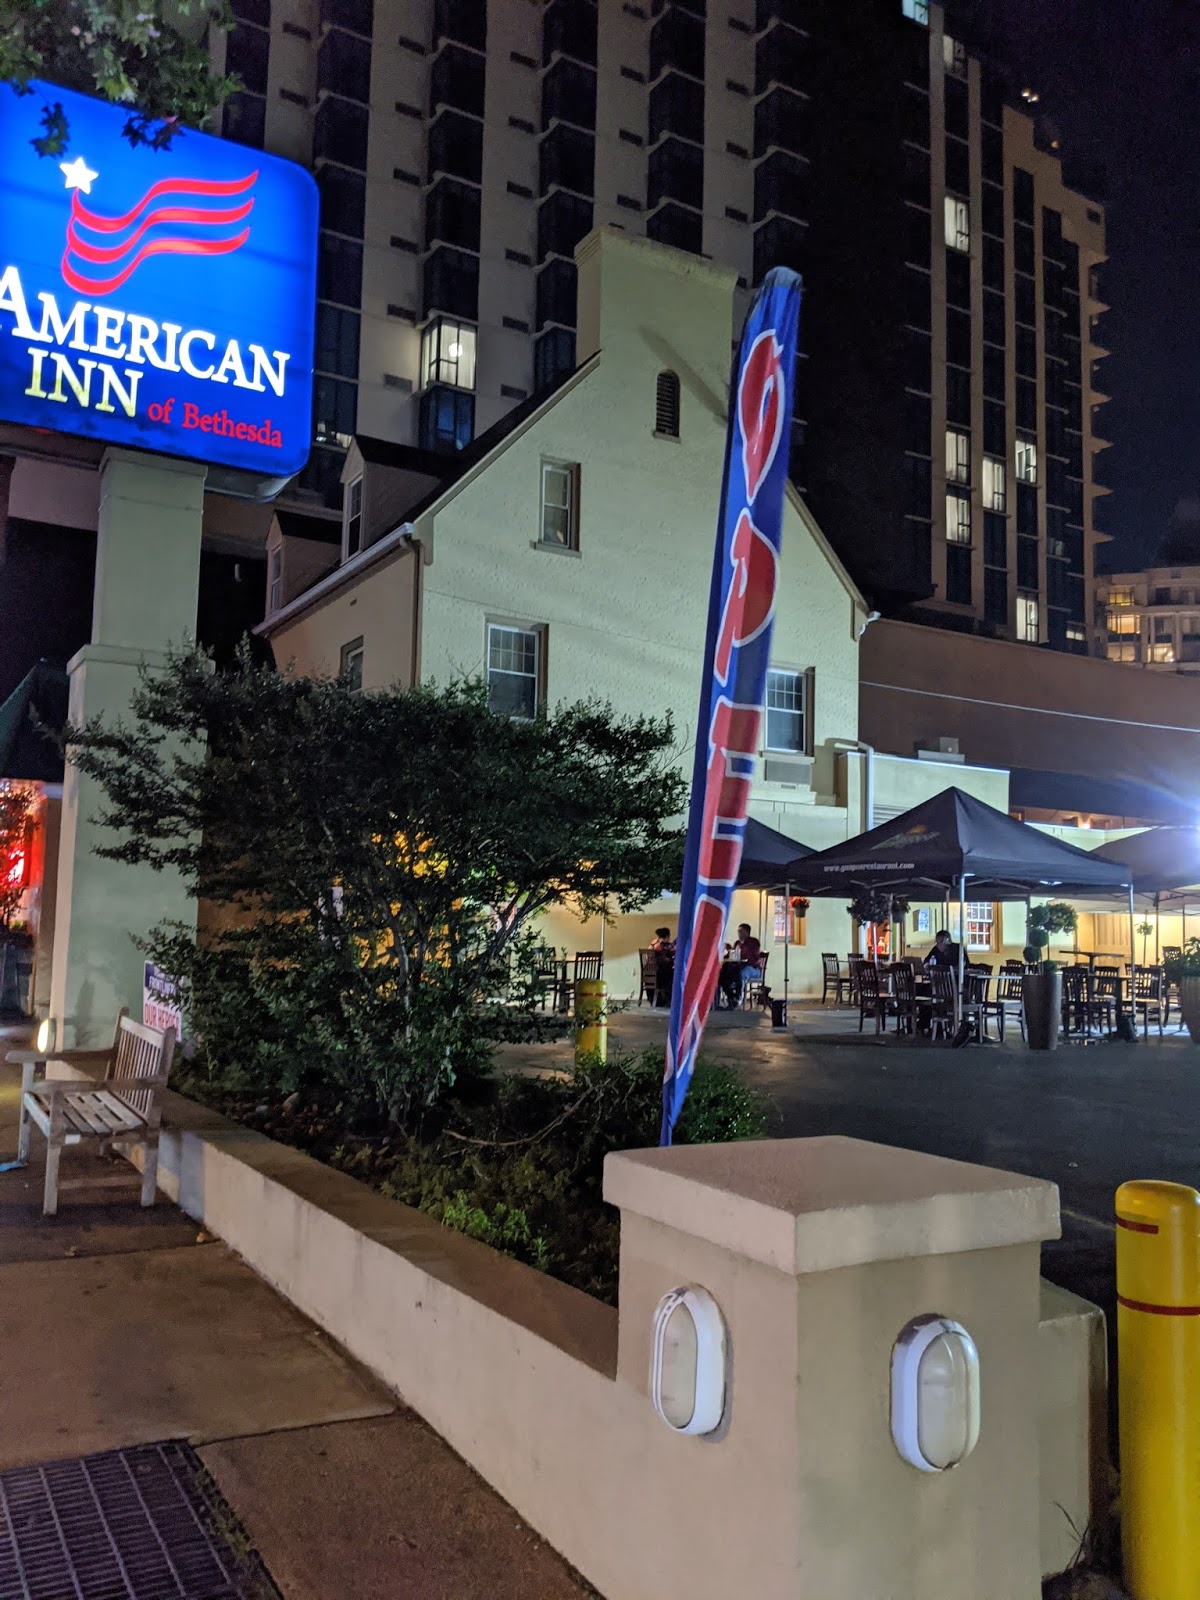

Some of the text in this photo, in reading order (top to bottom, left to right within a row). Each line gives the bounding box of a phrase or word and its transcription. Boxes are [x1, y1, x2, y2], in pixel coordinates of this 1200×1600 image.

[0, 265, 290, 397] AMERICAN
[25, 347, 283, 449] INN of Bethesda
